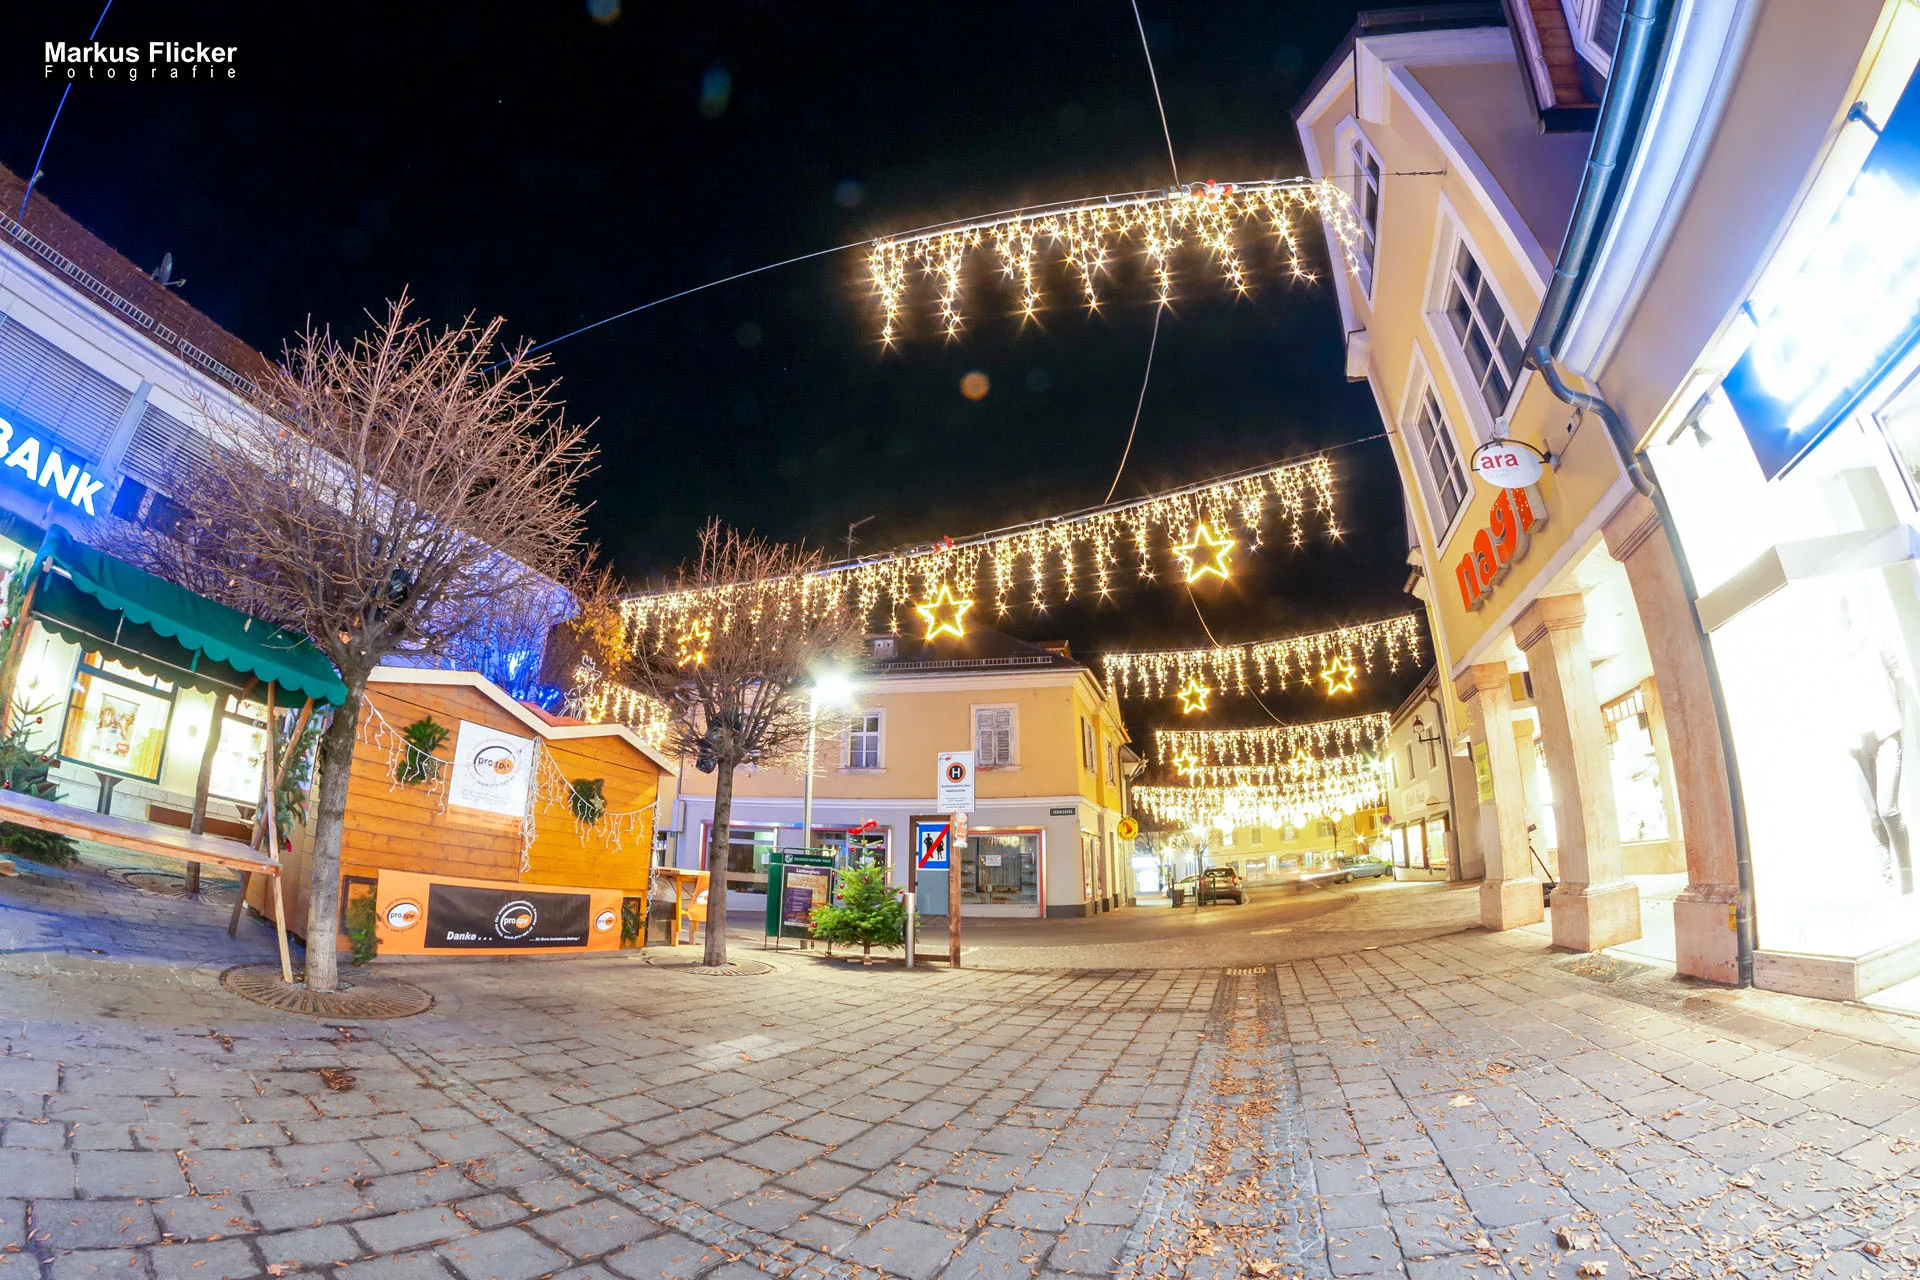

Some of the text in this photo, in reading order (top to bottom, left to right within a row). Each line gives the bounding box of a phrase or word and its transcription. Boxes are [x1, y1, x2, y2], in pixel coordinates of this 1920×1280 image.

[1480, 453, 1519, 470] ara
[952, 767, 960, 778] H
[402, 912, 415, 920] spe
[503, 917, 516, 925] pro
[446, 931, 477, 941] Danke
